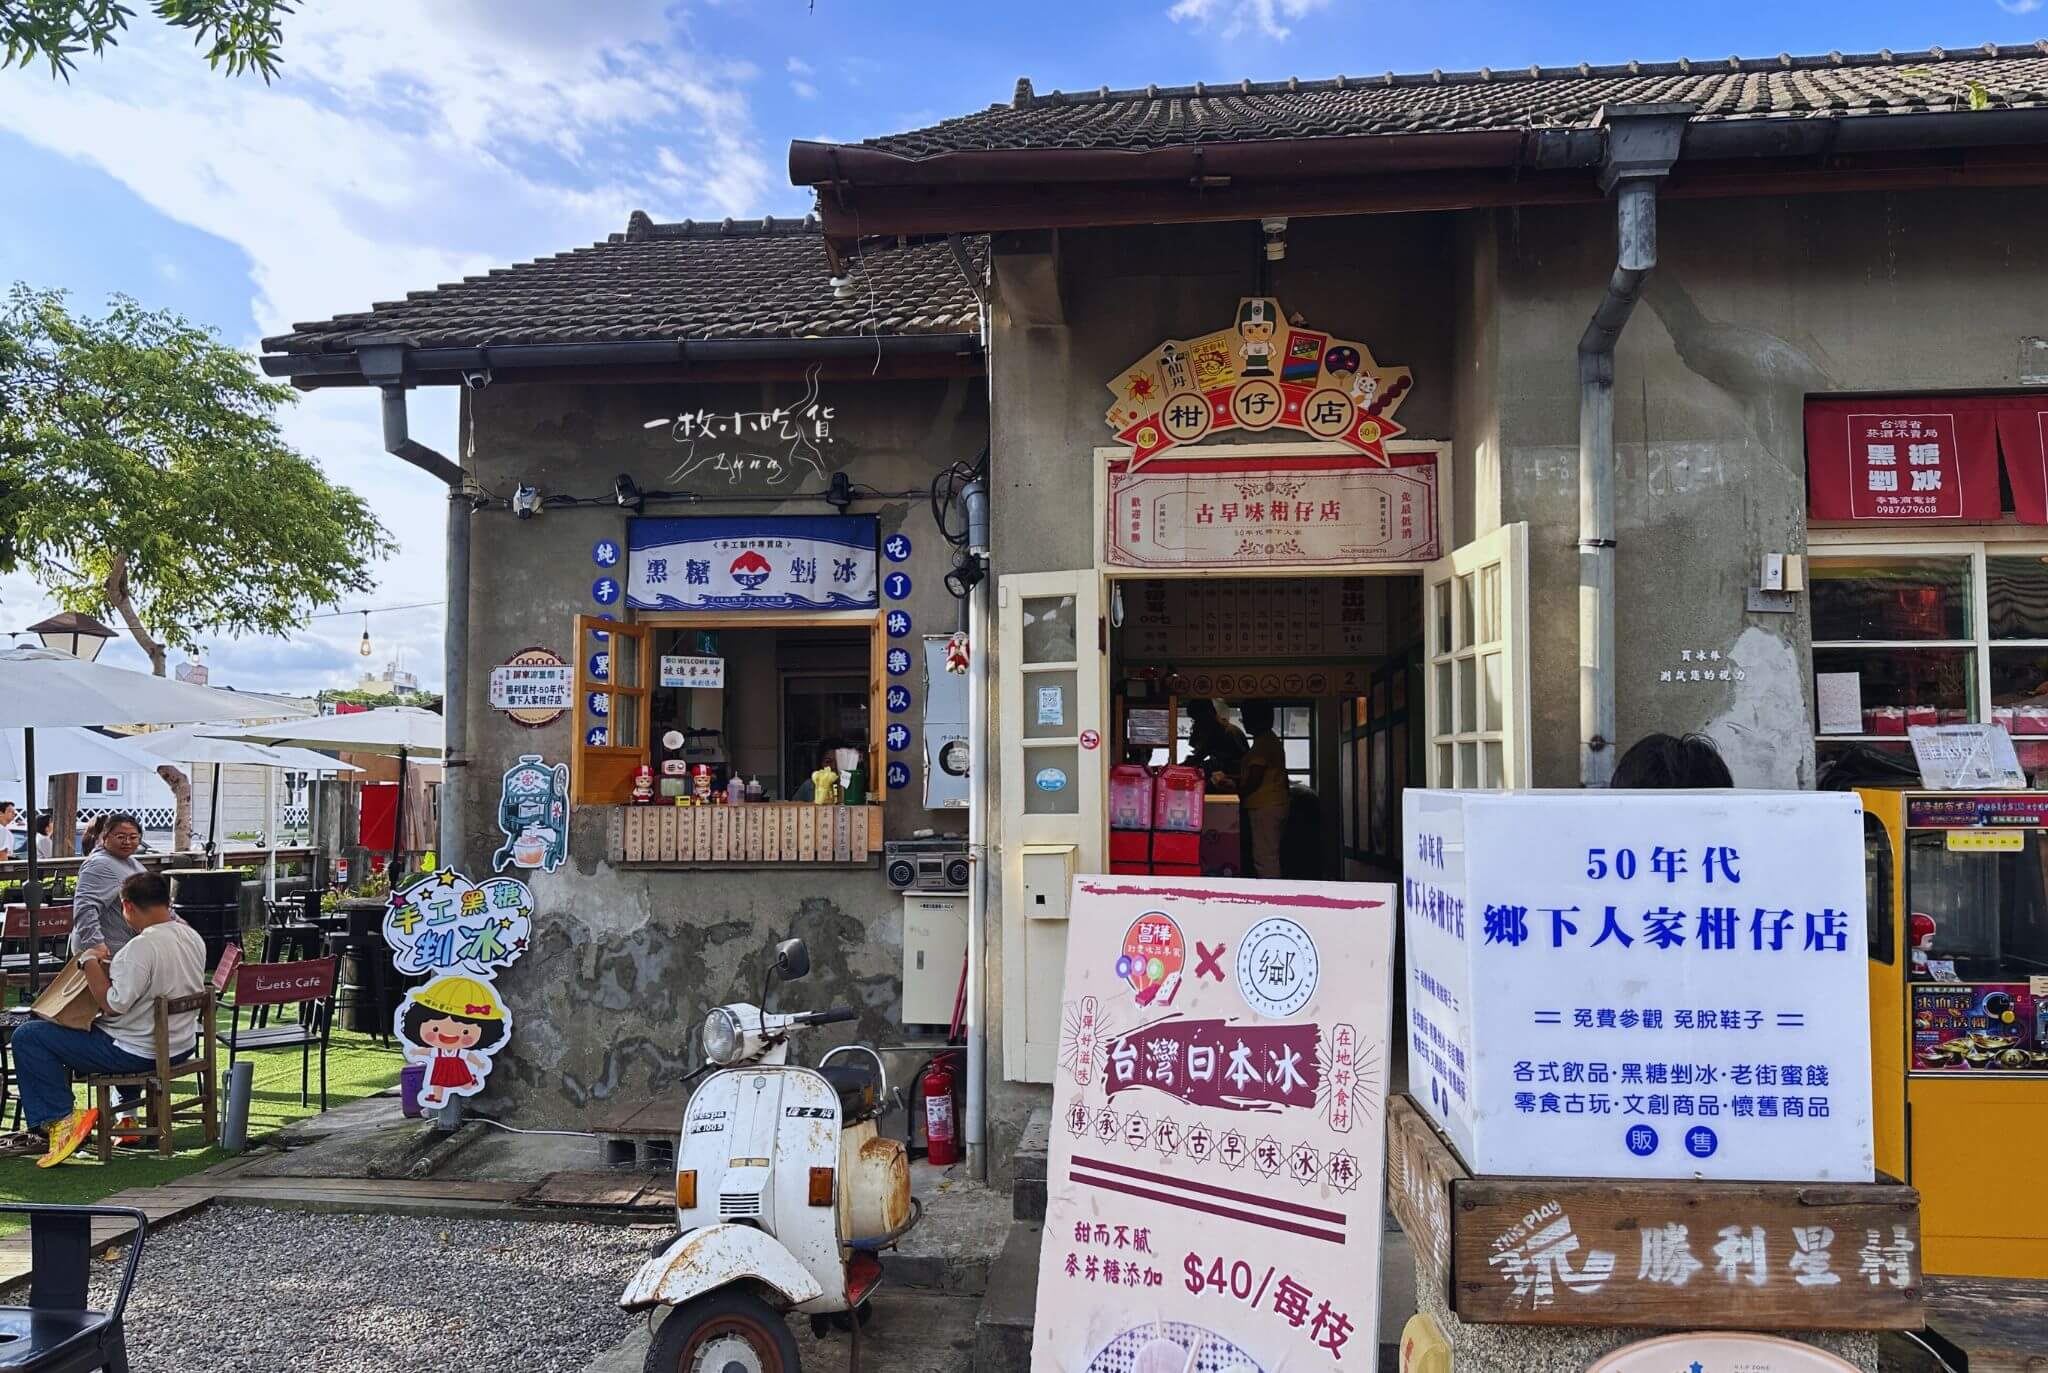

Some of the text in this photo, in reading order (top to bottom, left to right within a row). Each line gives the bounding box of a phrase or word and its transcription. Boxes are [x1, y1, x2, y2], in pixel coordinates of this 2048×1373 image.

[1170, 392, 1347, 429] 柑仔店
[1867, 443, 1940, 466] 黑糖
[1195, 500, 1341, 524] 古早味柑仔店
[1876, 505, 1937, 514] 0987679608
[646, 558, 710, 585] 黑糖
[885, 537, 908, 786] 吃了快樂似神仙
[1587, 846, 1742, 884] 50年代
[390, 882, 523, 935] 手工黑糖
[1484, 904, 1849, 953] 鄉下人家柑仔店
[1573, 1008, 1765, 1031] 免費參觀 免脫鞋子
[1112, 1037, 1310, 1095] 台灣日本冰
[1332, 1028, 1352, 1128] 在地好食材
[1070, 1106, 1354, 1185] 傳承三代古早味冰棒
[1074, 1220, 1153, 1255] 甜而不膩
[1064, 1252, 1163, 1288] 麥芽糖添加
[1183, 1251, 1354, 1361] $40/每枝
